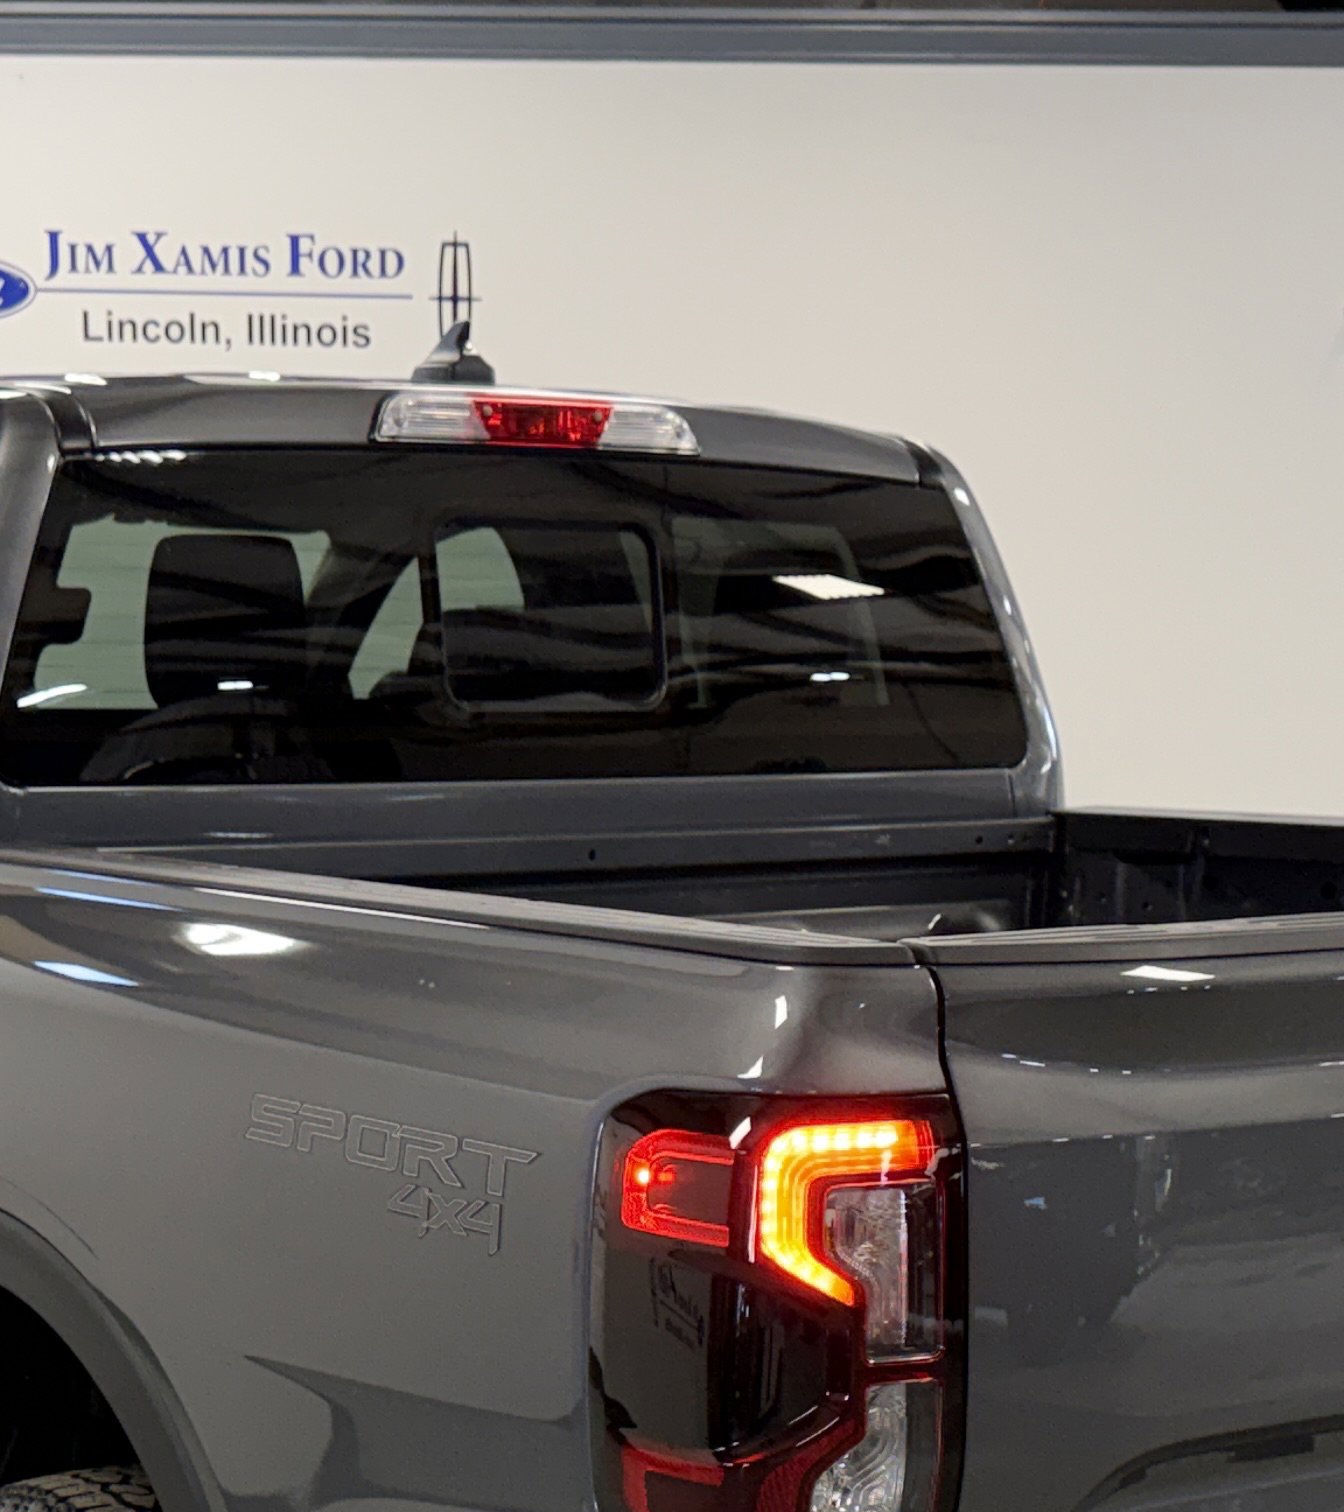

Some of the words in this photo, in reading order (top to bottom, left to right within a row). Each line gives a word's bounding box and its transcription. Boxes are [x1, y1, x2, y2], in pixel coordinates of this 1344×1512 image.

[44, 229, 116, 281] JIM
[131, 231, 271, 278] XAMIS
[286, 233, 405, 279] FORD
[82, 309, 232, 352] Lincoln,
[247, 313, 371, 349] Illinois
[245, 1092, 543, 1198] SPORT
